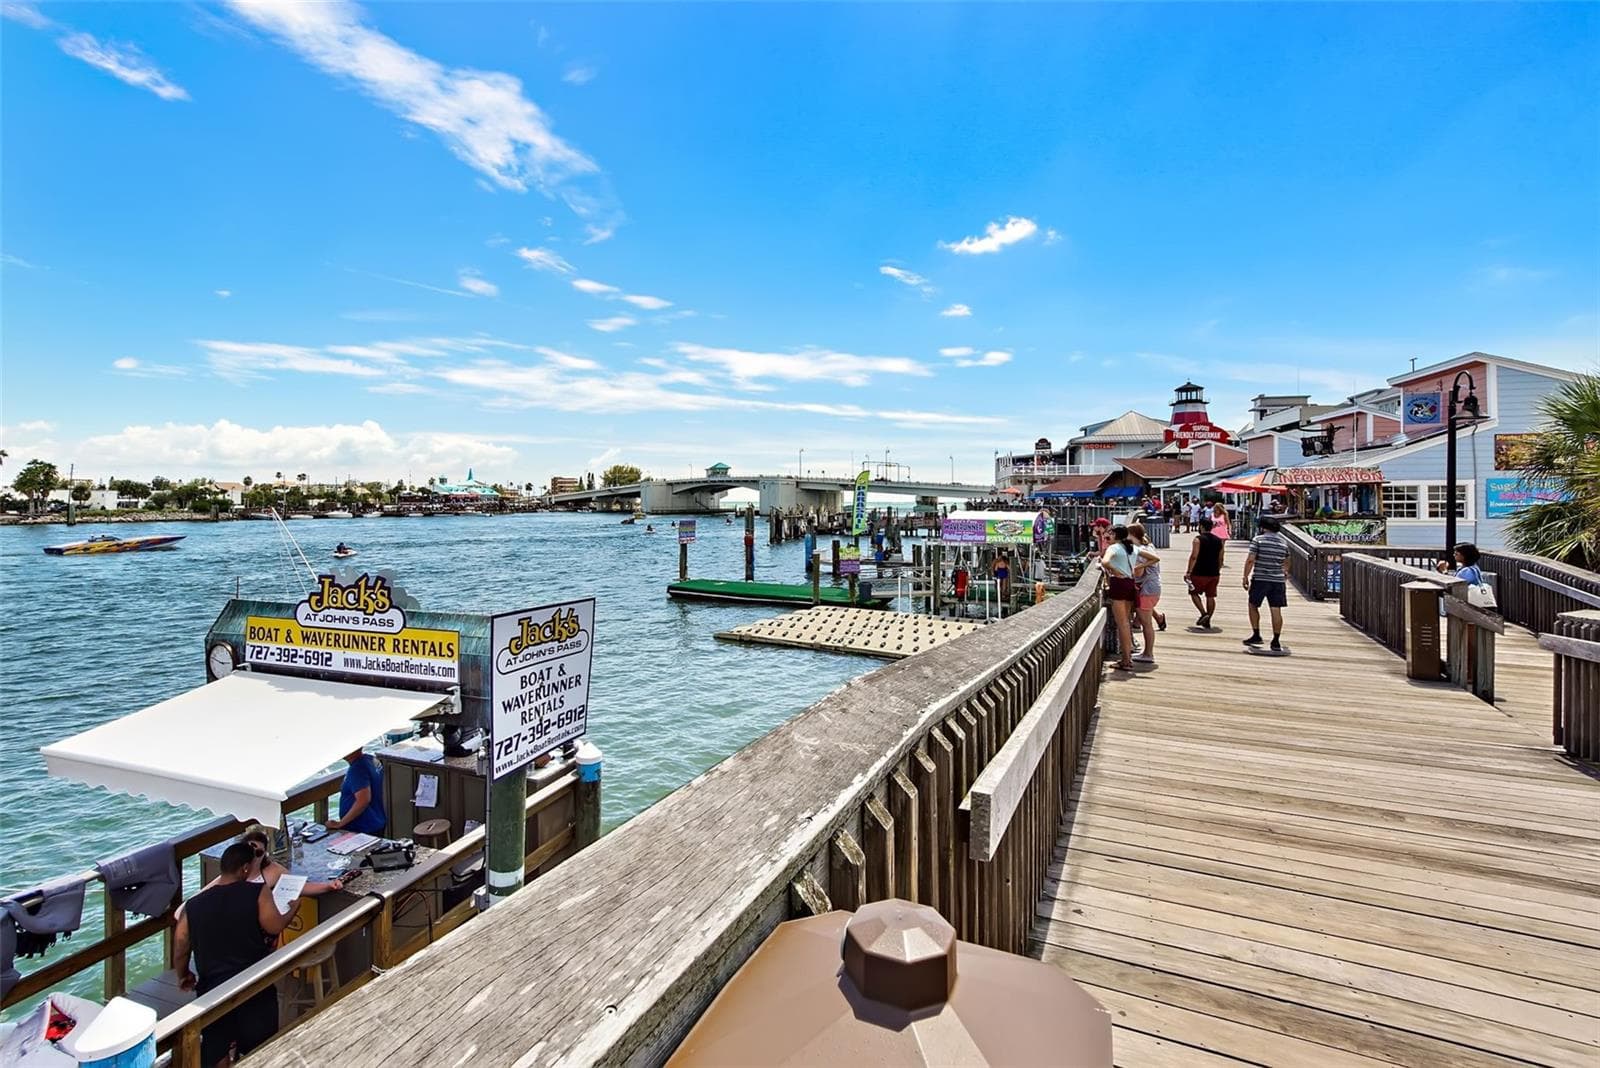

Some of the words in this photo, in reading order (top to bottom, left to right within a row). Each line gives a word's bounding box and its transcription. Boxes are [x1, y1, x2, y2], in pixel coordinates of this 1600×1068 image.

[1173, 431, 1194, 439] FRIENDLY
[1195, 432, 1221, 440] FISHERMAN
[1279, 472, 1384, 483] INFORMATION
[308, 575, 392, 614] Jack's
[304, 613, 319, 622] AT
[319, 614, 360, 625] JOHN'S
[364, 617, 395, 628] PASS
[509, 608, 581, 656] Jack's
[249, 626, 280, 642] BOAT
[285, 629, 295, 644] &
[301, 630, 386, 652] WAVERUNNER
[392, 638, 455, 658] RENTALS
[505, 657, 519, 668] AT
[518, 648, 555, 665] JOHN'S
[556, 640, 582, 653] PASS
[249, 644, 333, 668] 727-392-6912
[343, 656, 456, 678] www.JacksBoatRentals.com
[520, 666, 553, 690] BOAT
[558, 663, 567, 678] &
[502, 674, 582, 715] WAVERUNNER
[520, 695, 565, 726] RENTALS
[495, 704, 586, 761] 727-392-6912
[495, 724, 584, 774] www.JacksBoatRentals.com
